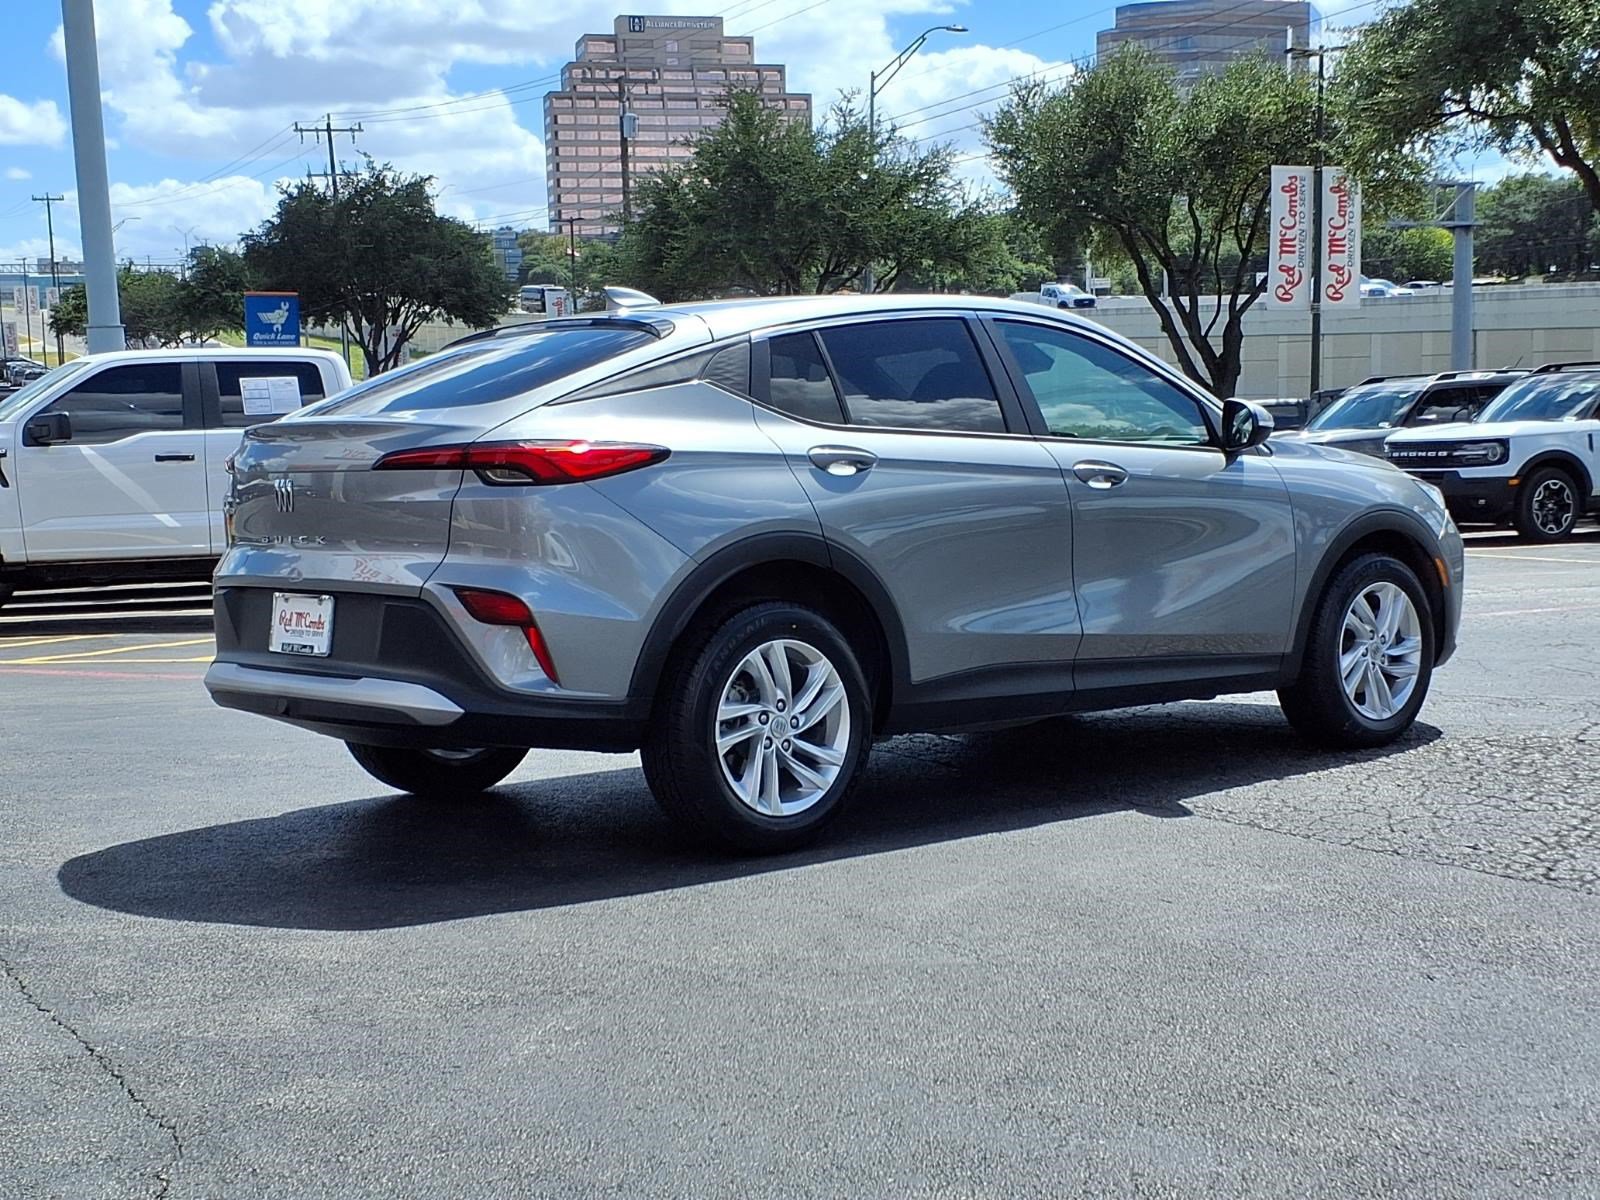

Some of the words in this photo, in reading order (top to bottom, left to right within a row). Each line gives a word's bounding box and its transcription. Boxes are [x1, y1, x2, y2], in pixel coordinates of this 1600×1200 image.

[1298, 175, 1306, 208] SERVE
[1278, 175, 1299, 262] McCombs
[1298, 210, 1306, 225] TO
[1347, 210, 1355, 225] TO
[1297, 228, 1306, 269] DRIVEN
[1347, 228, 1355, 268] DRIVEN
[1274, 264, 1303, 303] Red
[1325, 263, 1352, 302] Red
[253, 332, 276, 340] Quick
[276, 332, 296, 340] Lane
[261, 535, 327, 545] BUICK
[279, 609, 294, 633] Red
